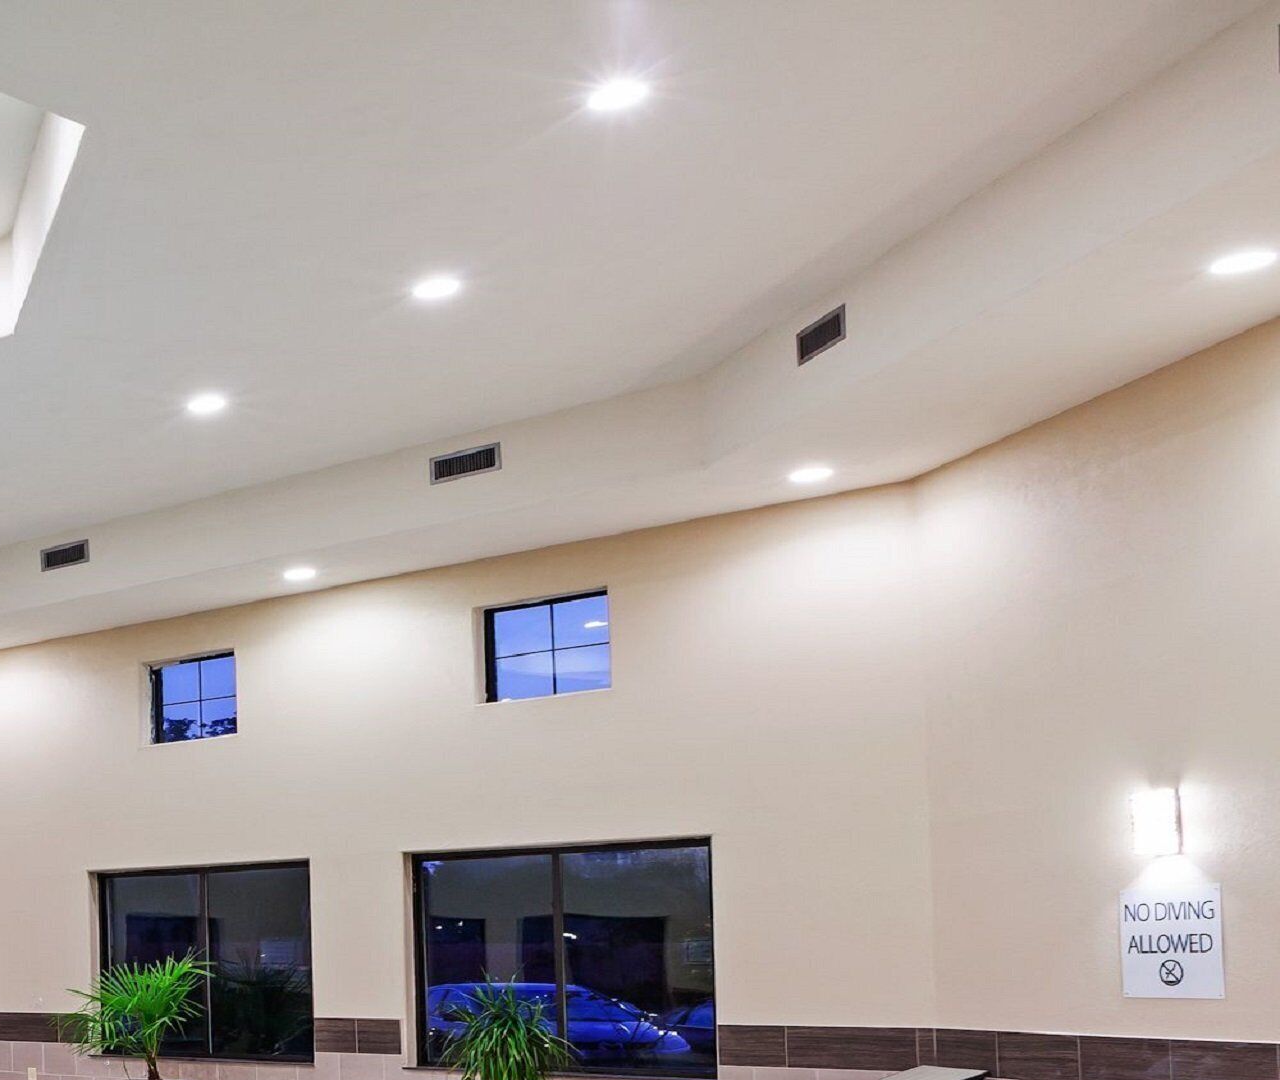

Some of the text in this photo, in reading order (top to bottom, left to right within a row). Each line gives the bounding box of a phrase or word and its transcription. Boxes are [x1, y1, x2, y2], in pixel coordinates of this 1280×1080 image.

[1124, 901, 1215, 922] NO DIVING
[1128, 933, 1213, 954] ALLOWED
